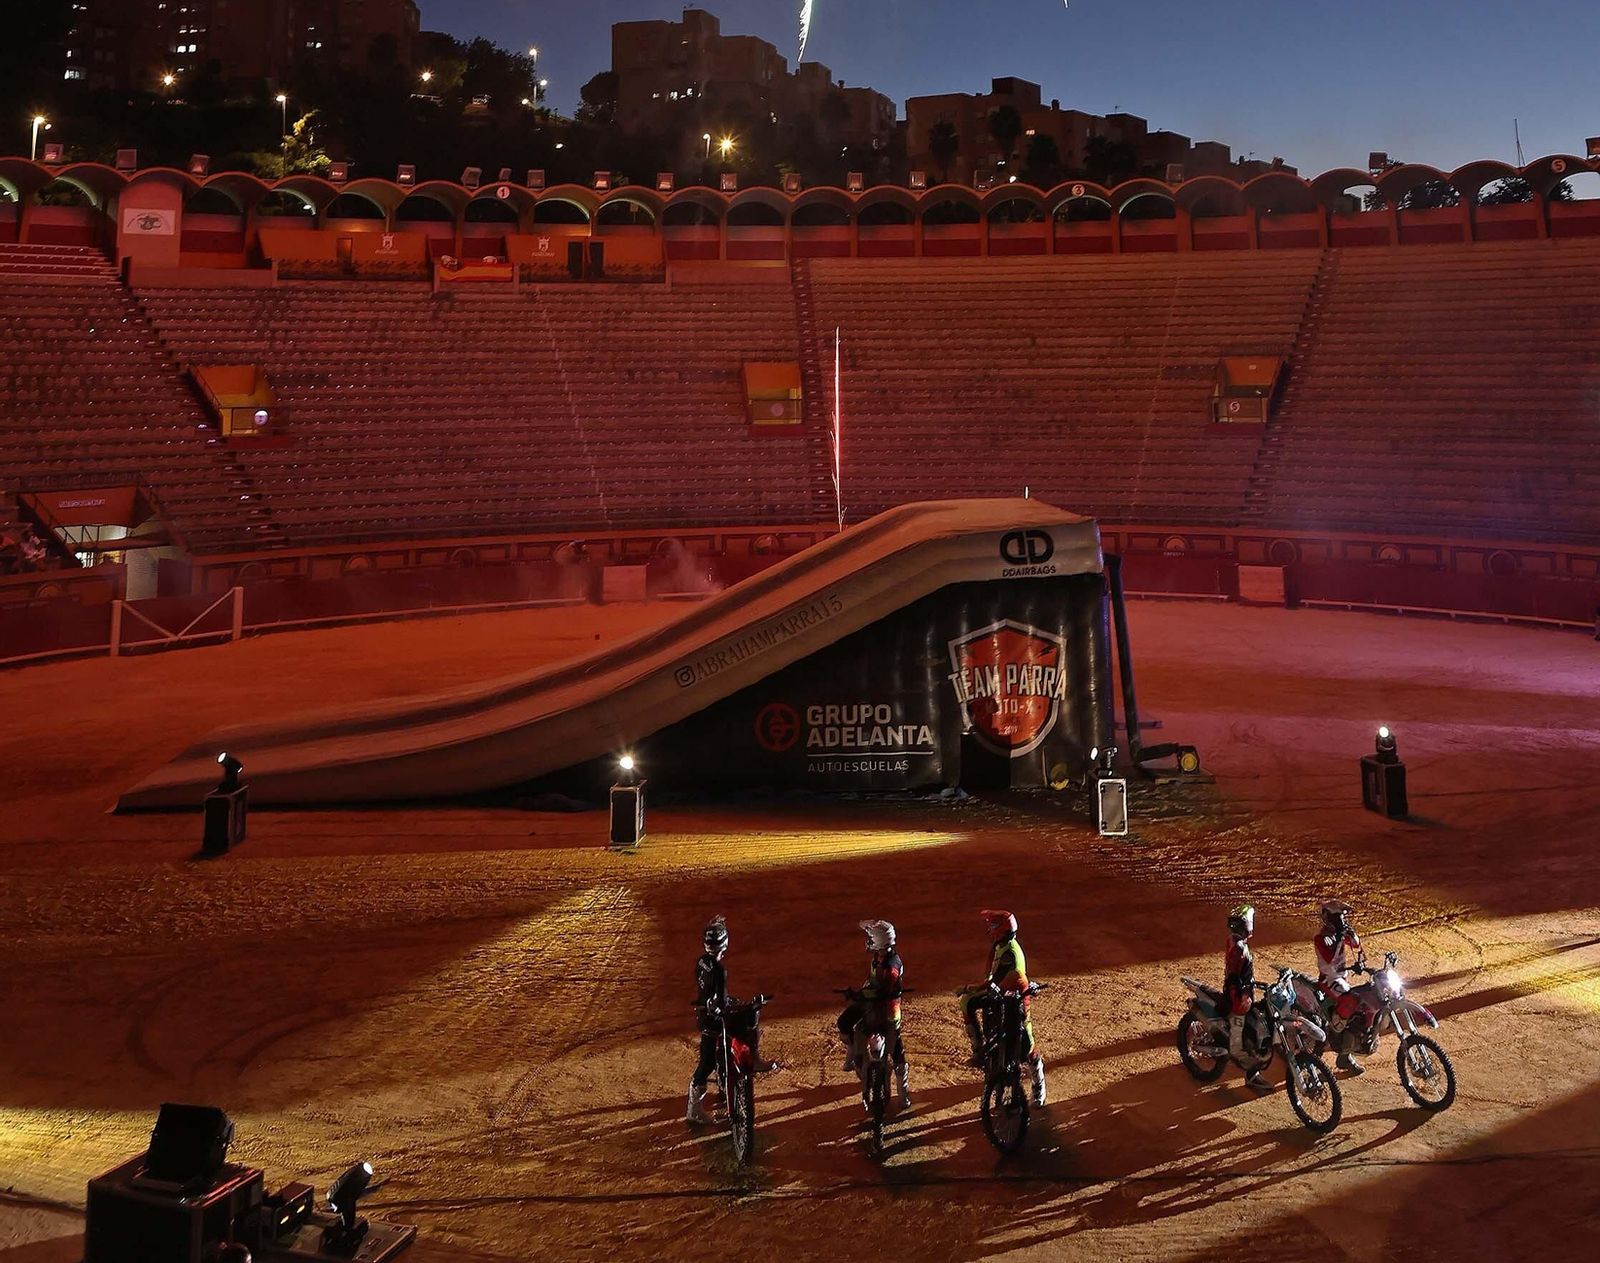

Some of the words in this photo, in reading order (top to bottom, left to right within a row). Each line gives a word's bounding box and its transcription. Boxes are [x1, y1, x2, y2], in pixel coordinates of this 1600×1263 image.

[1002, 565, 1057, 577] DDAIRBAGS
[948, 664, 1001, 703] TEAM
[1005, 663, 1067, 701] PARRA
[806, 703, 892, 725] GRUPO
[806, 725, 934, 748] ADELANTA
[807, 759, 910, 773] AUTOESCUELAS
